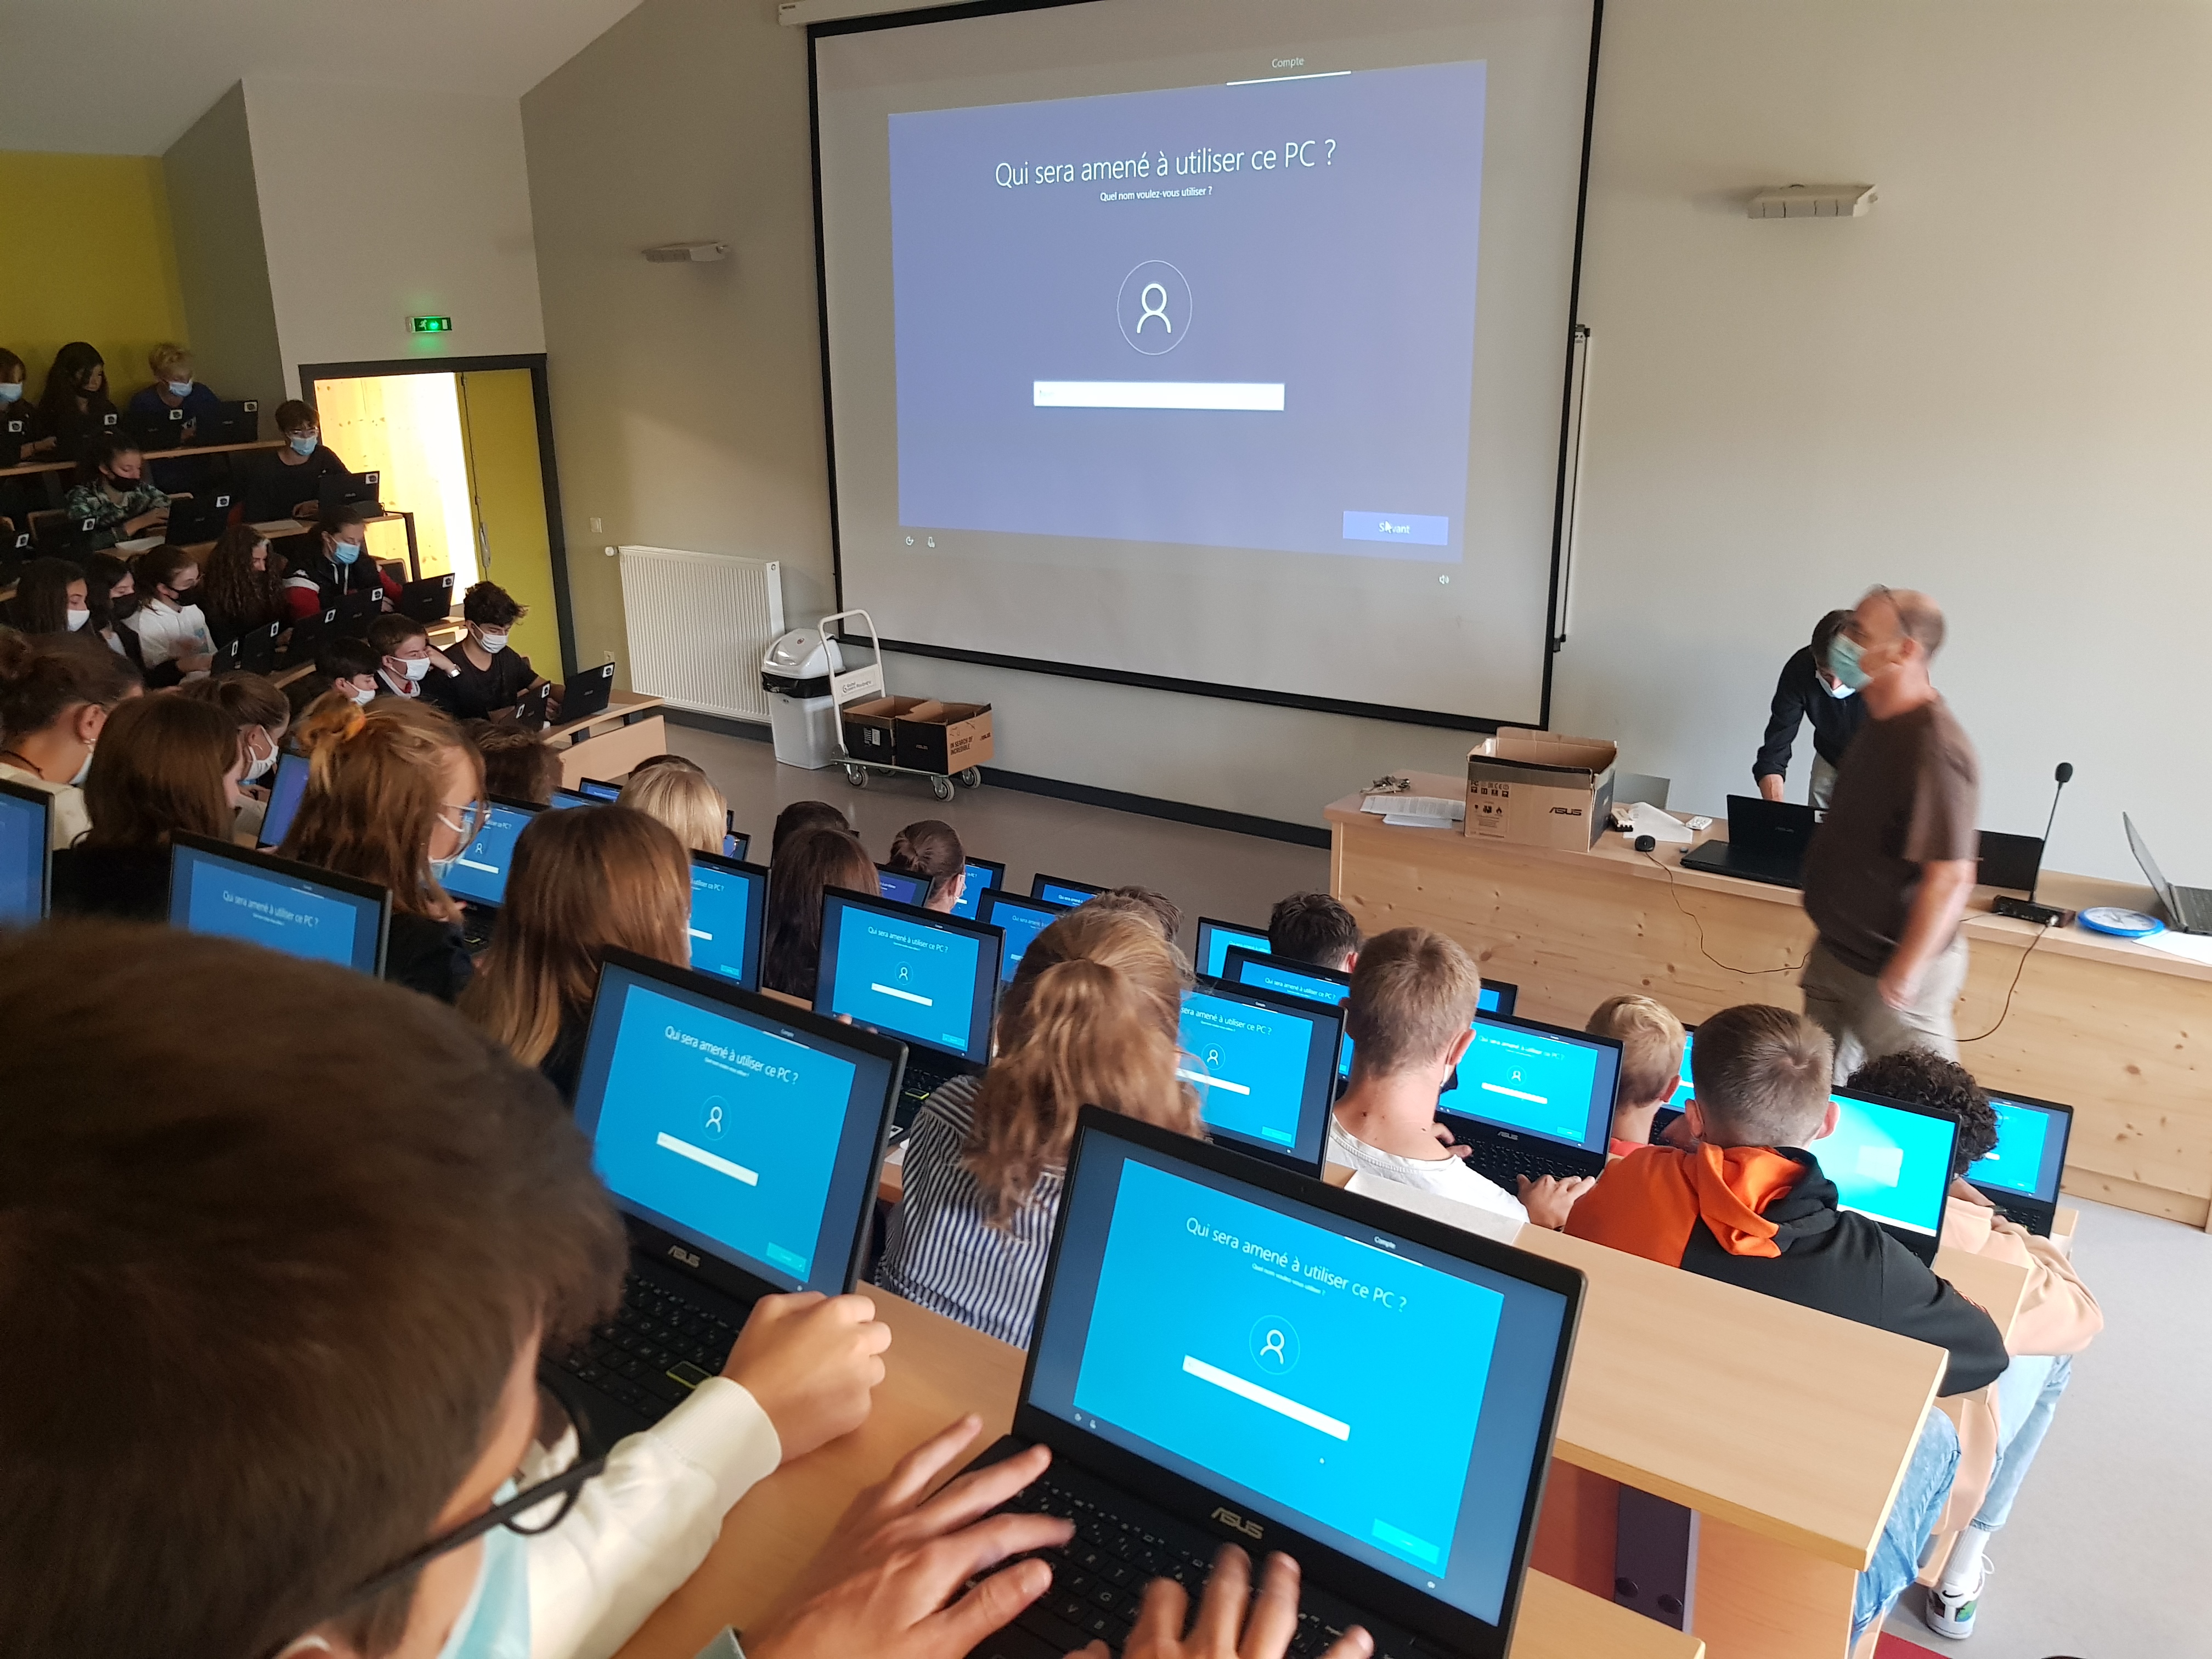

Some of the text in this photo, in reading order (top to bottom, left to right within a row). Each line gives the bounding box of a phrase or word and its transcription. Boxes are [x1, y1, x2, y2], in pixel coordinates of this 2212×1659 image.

[1272, 57, 1305, 69] Compte
[995, 138, 1336, 189] Qui sera amené à utiliser ce PC ?
[1100, 186, 1213, 202] Quel nom voulez-vous utiliser ?
[1378, 522, 1410, 534] Svant
[950, 744, 970, 755] INCREDIBLE
[955, 737, 968, 747] SEARCH
[1549, 806, 1582, 816] ASUS
[868, 926, 877, 934] Qui
[936, 944, 944, 952] PC
[1325, 991, 1333, 999] PC
[1181, 1007, 1194, 1015] sera
[1195, 1011, 1218, 1021] amené
[1224, 1017, 1246, 1028] utiliser
[1256, 1024, 1267, 1034] PC
[665, 1025, 681, 1041] Qui
[681, 1034, 698, 1048] sera
[699, 1041, 729, 1059] amené
[728, 1049, 736, 1062] à
[736, 1054, 765, 1073] utiliser
[765, 1065, 776, 1077] ce
[777, 1066, 792, 1083] PC
[792, 1072, 799, 1085] ?
[1497, 1131, 1519, 1141] ASUS
[668, 1245, 701, 1268] ASUS
[1187, 1217, 1407, 1312] Qui sera amené à utiliser ce PC ?
[1211, 1507, 1264, 1539] ASUS
